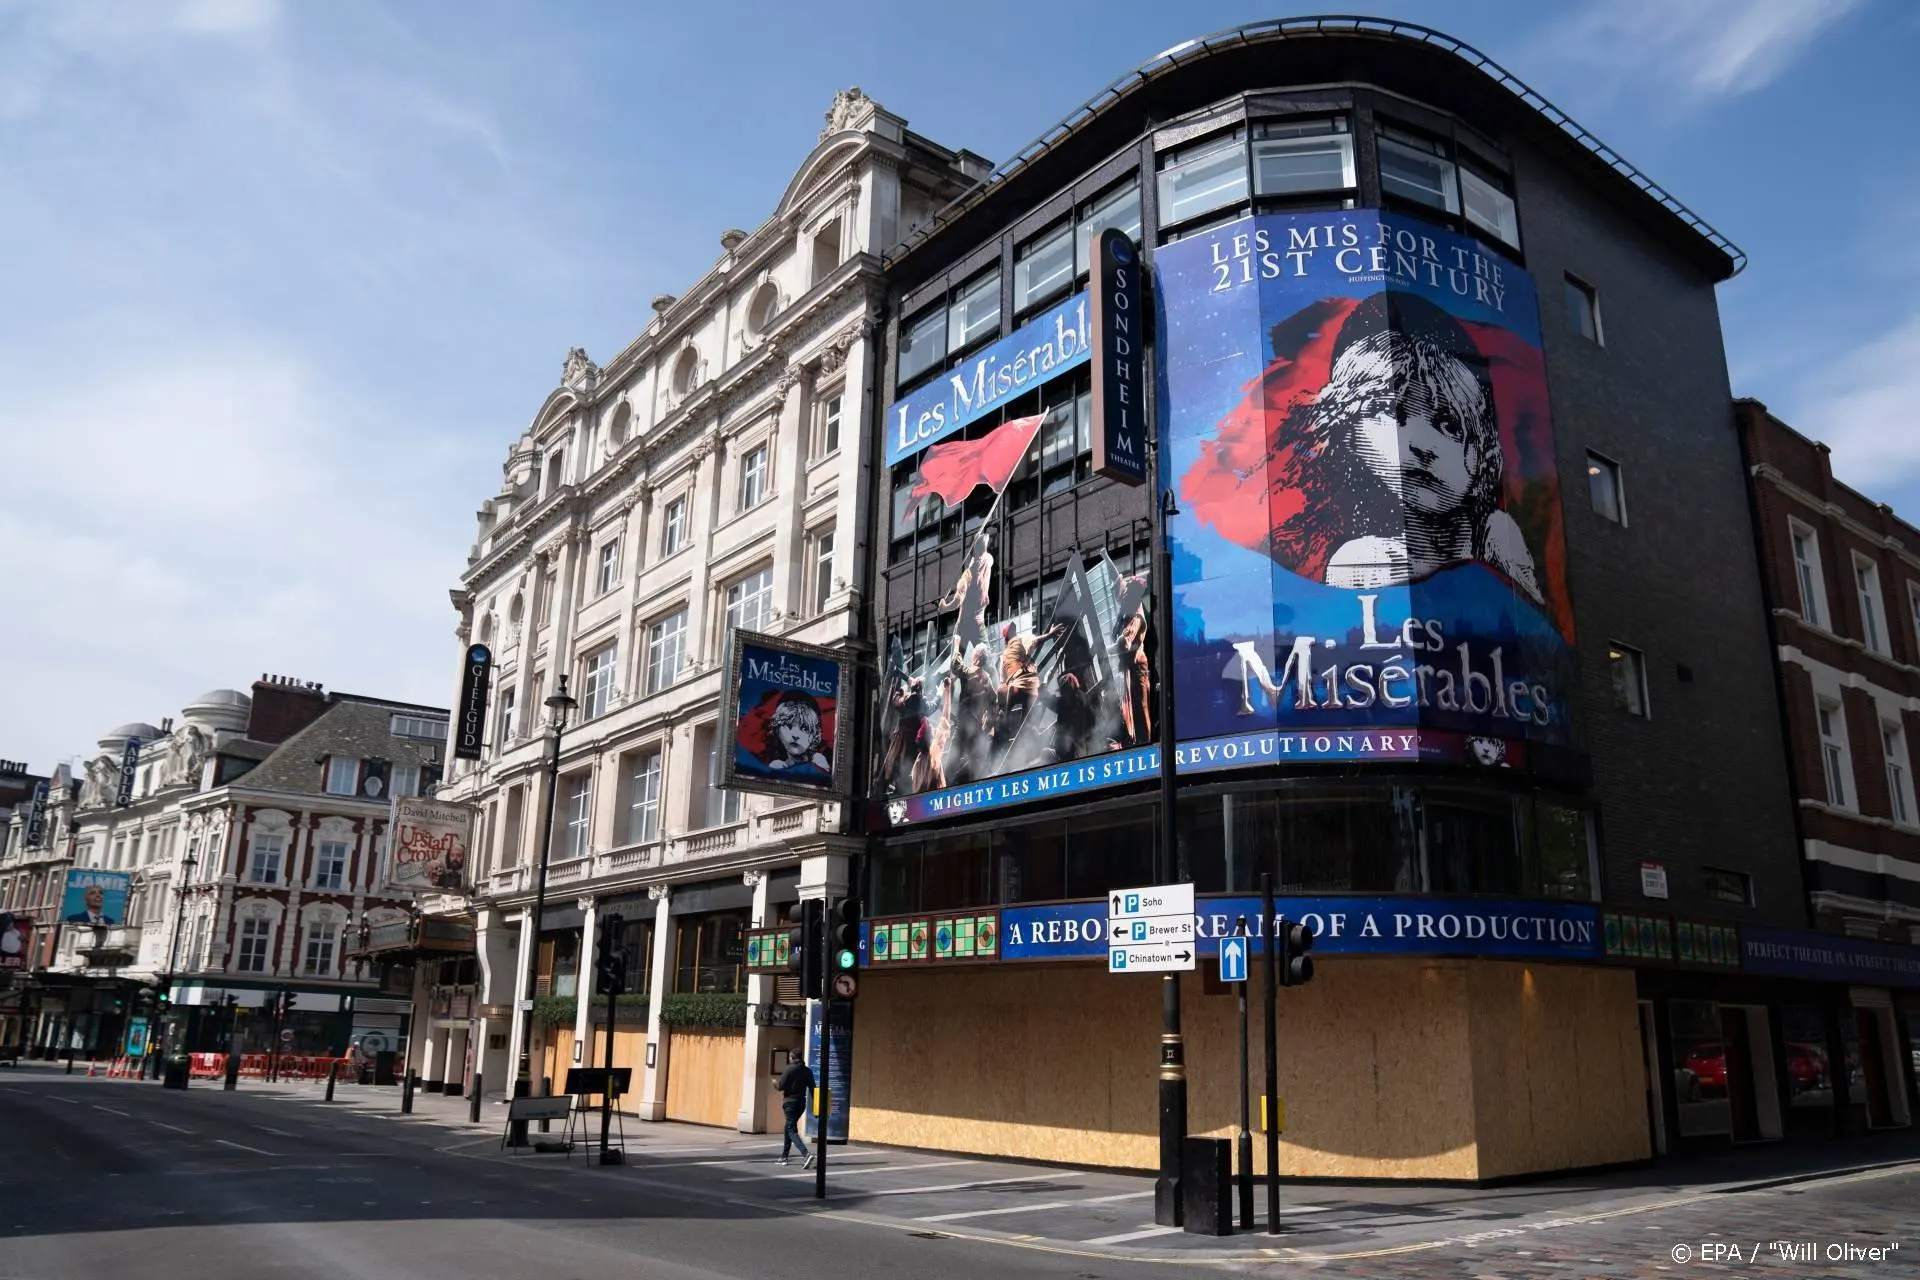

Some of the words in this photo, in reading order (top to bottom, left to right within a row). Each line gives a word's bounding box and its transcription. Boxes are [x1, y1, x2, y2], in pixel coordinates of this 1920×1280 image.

[1210, 229, 1270, 265] LES
[1288, 223, 1360, 251] MIS
[1379, 223, 1439, 263] FOR
[1451, 245, 1505, 289] THE
[1213, 250, 1314, 292] 21ST
[1335, 247, 1505, 314] CENTURY
[1114, 268, 1134, 455] SONDHEIM
[897, 401, 946, 453] Les
[1110, 452, 1141, 471] THEATRE
[1357, 594, 1445, 652] Les
[748, 658, 832, 693] Misérables
[779, 656, 800, 672] Les
[1232, 636, 1550, 726] Misérables
[464, 665, 483, 746] GIELGUD
[118, 748, 136, 804] APOLLO
[1001, 779, 1030, 798] LES
[1038, 771, 1070, 791] MIZ
[1079, 766, 1096, 783] IS
[1103, 753, 1160, 778] STILL
[403, 806, 427, 817] David
[430, 811, 466, 822] Mitchell
[1142, 897, 1163, 907] Soho
[1149, 925, 1179, 935] Brewer
[1182, 924, 1191, 933] St
[1300, 913, 1346, 937] OF
[1360, 914, 1382, 937] A
[1129, 953, 1172, 964] Chinatown
